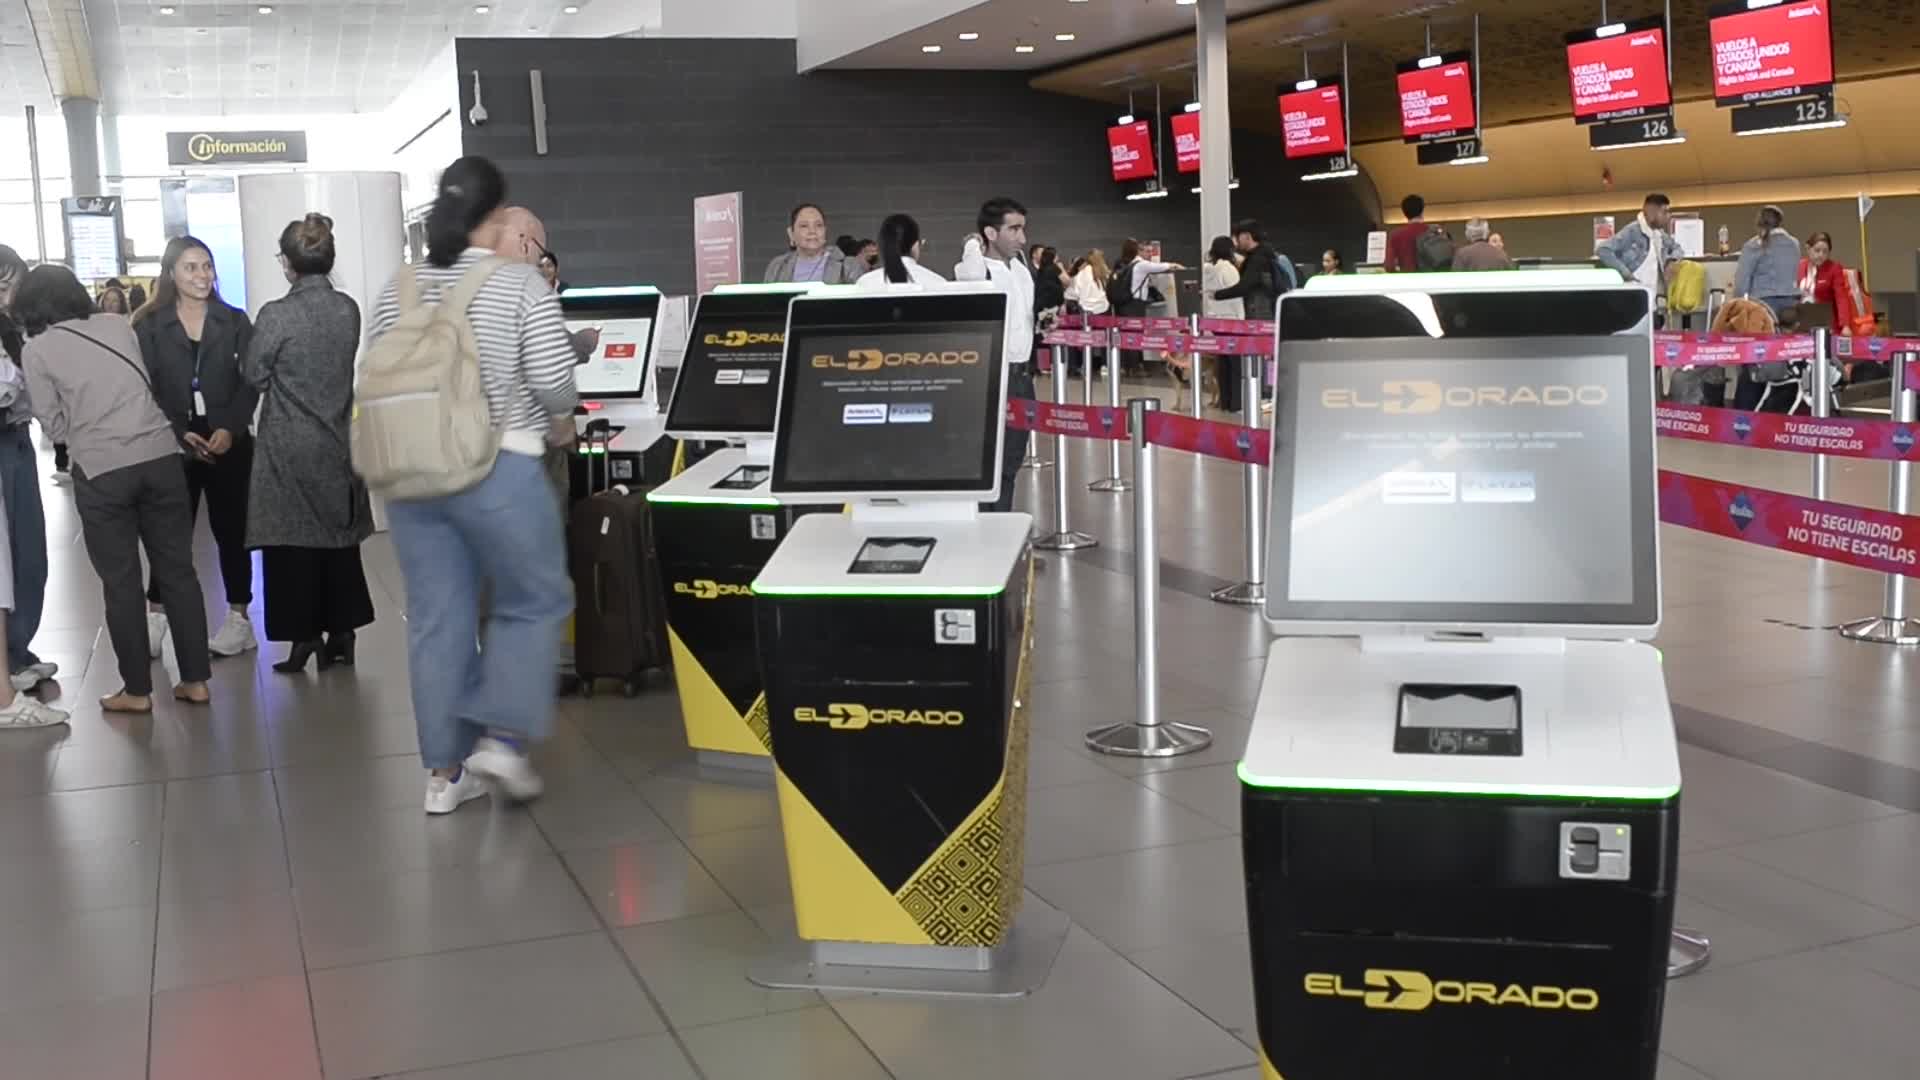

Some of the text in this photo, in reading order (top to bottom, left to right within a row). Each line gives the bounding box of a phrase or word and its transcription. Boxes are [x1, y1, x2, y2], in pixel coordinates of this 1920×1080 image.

[1715, 38, 1749, 52] VUELOS
[1716, 42, 1790, 64] ESTADOS UNIDOS
[1796, 101, 1827, 121] 125
[1643, 120, 1669, 138] 126
[1456, 141, 1475, 157] 127
[1330, 157, 1346, 171] 128
[704, 333, 725, 344] EL
[812, 349, 980, 370] EL DORADO
[1320, 380, 1609, 414] EL DORADO
[1673, 421, 1709, 434] ESCALAS
[1784, 422, 1854, 437] TU SEGURIDAD
[1774, 433, 1864, 450] NO TIENE ESCALAS
[1801, 510, 1903, 541] TU SEGURIDAD
[1787, 526, 1917, 565] NO TIENE ESCALAS
[674, 580, 755, 599] EL DORA
[794, 703, 964, 729] EL DORADO
[1304, 969, 1600, 1010] EL DORADO
